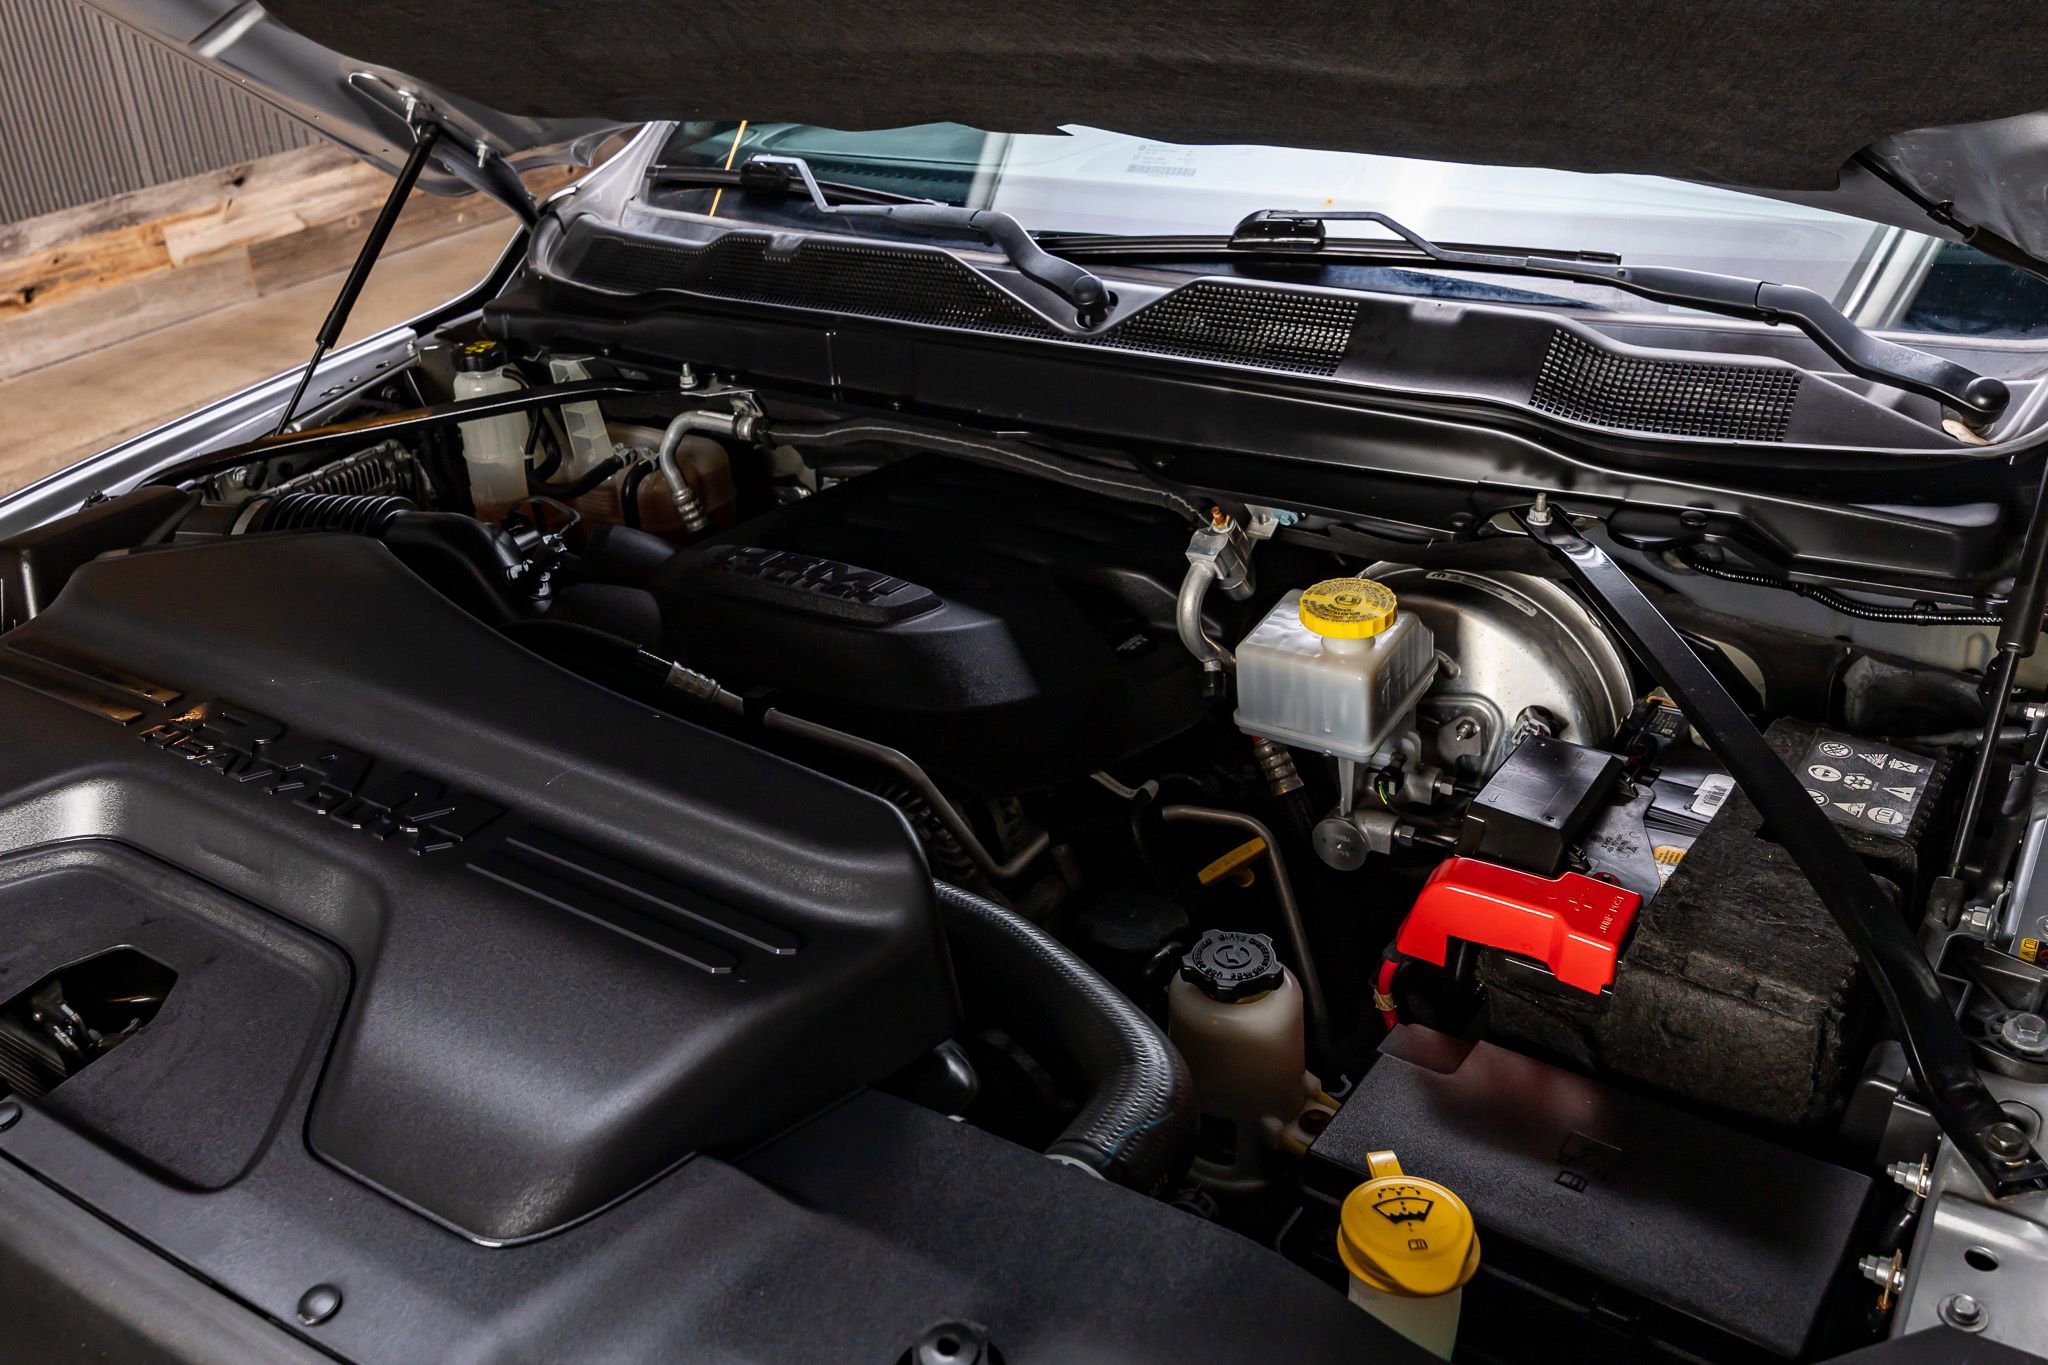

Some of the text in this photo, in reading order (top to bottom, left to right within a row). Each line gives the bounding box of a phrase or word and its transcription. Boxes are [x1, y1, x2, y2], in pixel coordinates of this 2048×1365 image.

[722, 546, 910, 603] HEMI
[138, 724, 458, 856] HEAVY DUTY
[168, 698, 511, 842] RAM
